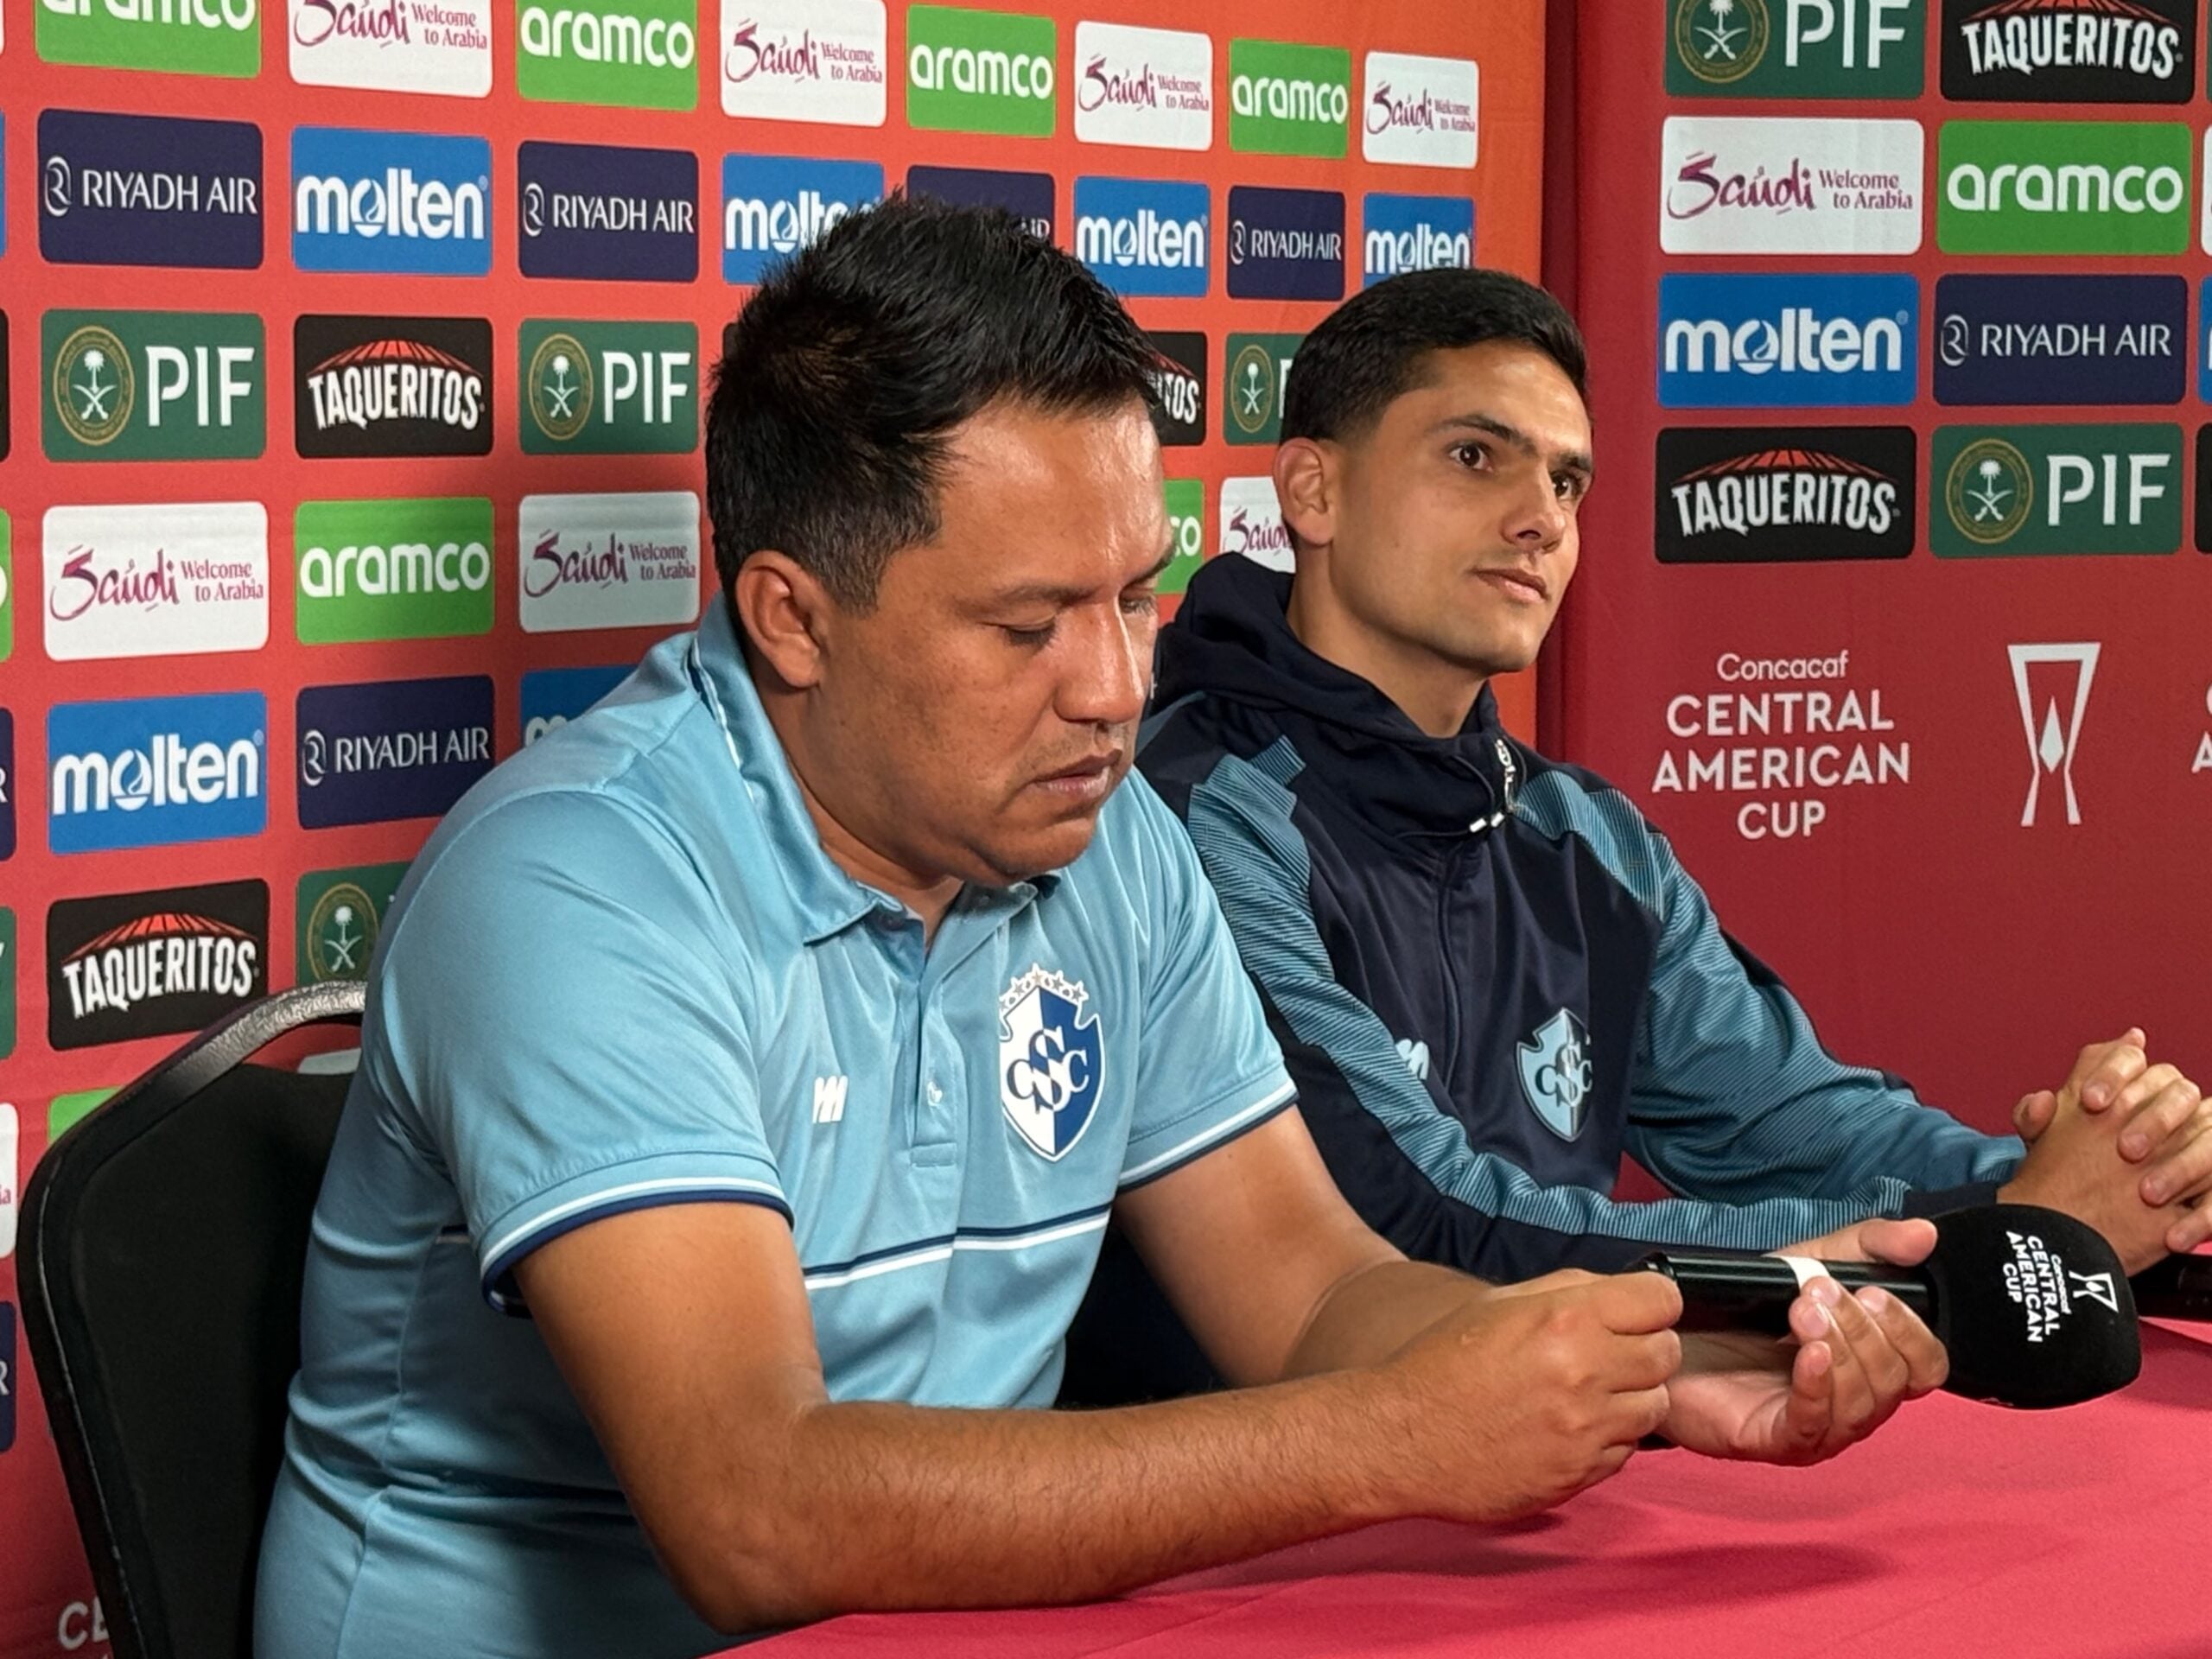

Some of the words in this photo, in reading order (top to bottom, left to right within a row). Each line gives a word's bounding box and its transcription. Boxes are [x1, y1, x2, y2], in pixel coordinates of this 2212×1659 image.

[412, 3, 476, 29] Welcome
[424, 29, 440, 44] to
[442, 29, 488, 50] Arabia
[521, 7, 695, 68] aramco
[1784, 0, 1906, 69] PIF
[821, 41, 874, 64] Welcome
[1961, 13, 2178, 79] TAQUERITOS
[831, 65, 843, 79] to
[846, 66, 882, 84] Arabia
[910, 44, 1053, 99] aramco
[1158, 74, 1202, 92] Welcome
[1166, 94, 1176, 109] to
[1179, 95, 1209, 111] Arabia
[1232, 74, 1348, 124] aramco
[83, 168, 199, 213] RIYADH
[207, 177, 258, 215] AIR
[1819, 168, 1900, 189] Welcome
[1833, 191, 1850, 210] to
[1853, 190, 1913, 211] Arabia
[1947, 163, 2183, 213] aramco
[296, 168, 485, 239] molten
[553, 194, 647, 232] RIYADH
[653, 200, 694, 234] AIR
[1077, 209, 1205, 268] molten
[1252, 229, 1313, 260] RIYADH
[1317, 233, 1342, 261] AIR
[1365, 223, 1471, 274] molten
[1665, 308, 1902, 374] molten
[1981, 323, 2106, 357] RIYADH
[2114, 323, 2172, 357] AIR
[145, 346, 255, 427] PIF
[308, 364, 482, 430] TAQUERITOS
[602, 351, 691, 424] PIF
[1671, 472, 1896, 537] TAQUERITOS
[2047, 454, 2171, 526] PIF
[181, 560, 252, 582] Welcome
[300, 542, 490, 598] aramco
[628, 542, 687, 562] Welcome
[639, 563, 655, 582] to
[657, 562, 696, 581] Arabia
[195, 582, 211, 602] to
[214, 579, 264, 601] Arabia
[1717, 649, 1849, 682] Concacaf
[1666, 689, 1895, 737] CENTRAL
[335, 731, 437, 772] RIYADH
[444, 726, 490, 762] AIR
[1651, 741, 1911, 794] AMERICAN
[53, 734, 259, 816] molten
[1737, 800, 1827, 841] CUP
[61, 934, 257, 1020] TAQUERITOS
[2002, 1262, 2023, 1304] CUP
[2005, 1230, 2044, 1344] AMERICAN
[2027, 1235, 2060, 1336] CENTRAL
